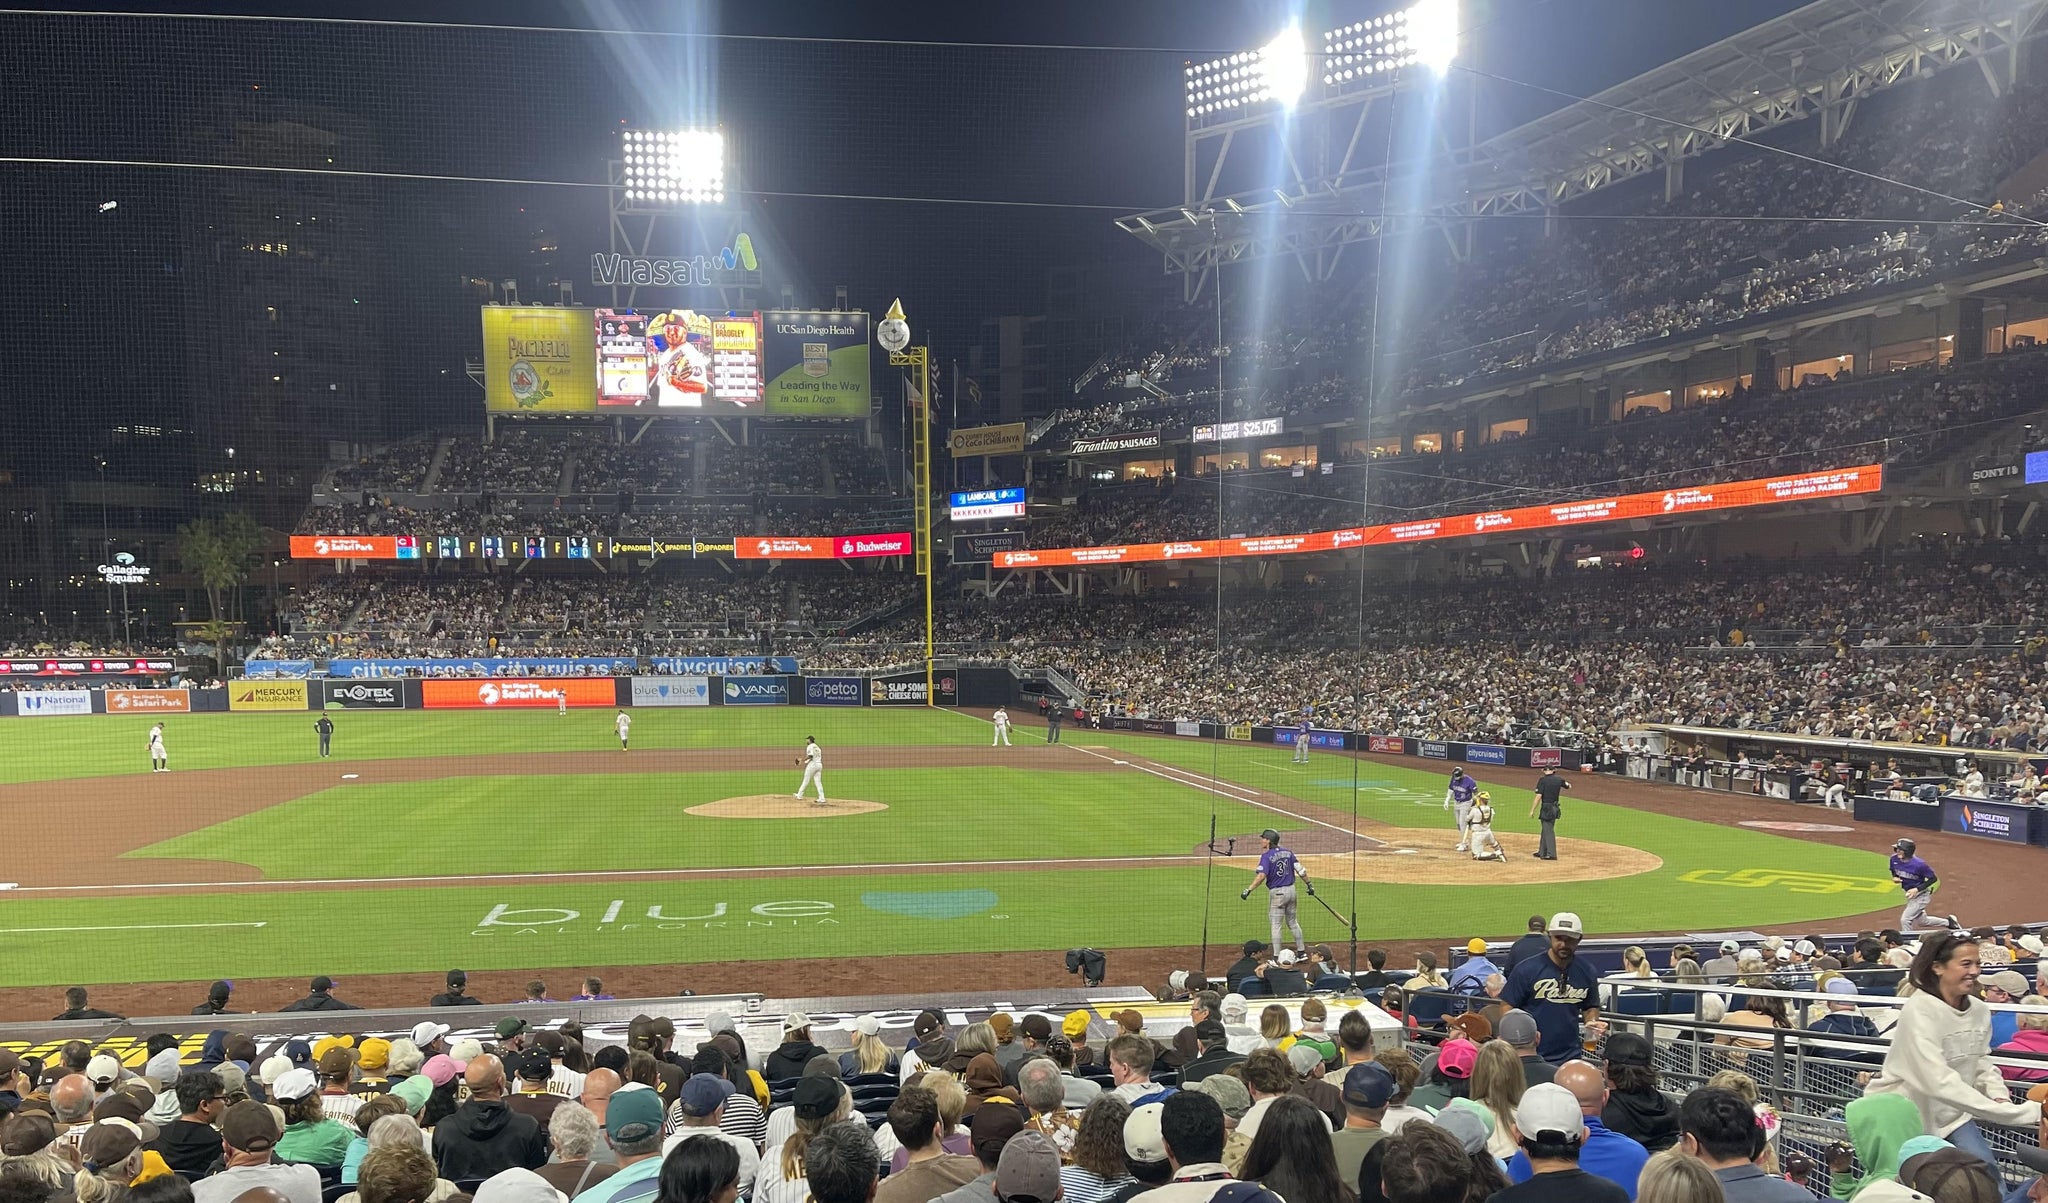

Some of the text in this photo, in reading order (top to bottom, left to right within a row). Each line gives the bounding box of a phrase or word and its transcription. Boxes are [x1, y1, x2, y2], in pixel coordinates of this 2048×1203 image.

[595, 253, 711, 286] Viasat
[777, 325, 855, 338] UC San Diego Health
[805, 345, 826, 353] BEST
[780, 381, 861, 392] Leading the Way
[792, 394, 809, 403] San
[812, 395, 836, 405] Diego
[1072, 436, 1158, 454] Tarantino SAUSAGES
[1973, 467, 2006, 480] SONY
[1767, 481, 1792, 490] PROUD
[1794, 477, 1828, 487] PARTNER
[1830, 475, 1841, 483] OF
[1792, 486, 1816, 495] DIEGO
[1818, 482, 1848, 492] PADRES
[426, 542, 432, 553] F
[454, 538, 460, 548] 1
[470, 542, 476, 553] F
[497, 538, 502, 548] 1
[512, 542, 518, 553] F
[539, 537, 546, 548] 7
[554, 542, 560, 553] F
[582, 537, 588, 548] 2
[597, 542, 603, 553] F
[856, 540, 902, 552] Budweiser
[974, 538, 1012, 546] SINGLETON
[331, 544, 378, 552] Safari Park
[454, 548, 462, 558] 0
[497, 548, 504, 558] 3
[540, 548, 546, 558] 1
[582, 548, 588, 558] 0
[622, 544, 652, 552] @PADRES
[704, 544, 734, 552] @PADRES
[773, 544, 794, 552] Safari
[98, 565, 150, 576] Gallagher
[106, 574, 144, 585] Square
[11, 663, 39, 671] TOYOTA
[58, 662, 85, 670] TOYOTA
[104, 662, 130, 670] TOYOTA
[147, 662, 172, 670] TOYOTA
[255, 688, 301, 696] MERCURY
[334, 684, 394, 701] EVOTEK
[634, 685, 658, 695] blue
[672, 685, 696, 695] blue
[740, 685, 787, 694] VANDA
[824, 682, 858, 698] petco
[888, 683, 907, 692] SLAP
[502, 688, 560, 699] Safari Park
[888, 692, 911, 700] CHEESE
[912, 692, 922, 700] ON
[44, 695, 86, 704] National
[133, 698, 182, 708] Safari Park
[1468, 749, 1498, 760] citycruises
[1973, 811, 2010, 824] SINGLETON
[1973, 820, 2010, 832] SCHREIBER
[477, 900, 836, 927] blue
[470, 917, 841, 936] CALIFORNIA
[549, 1082, 572, 1096] RILL
